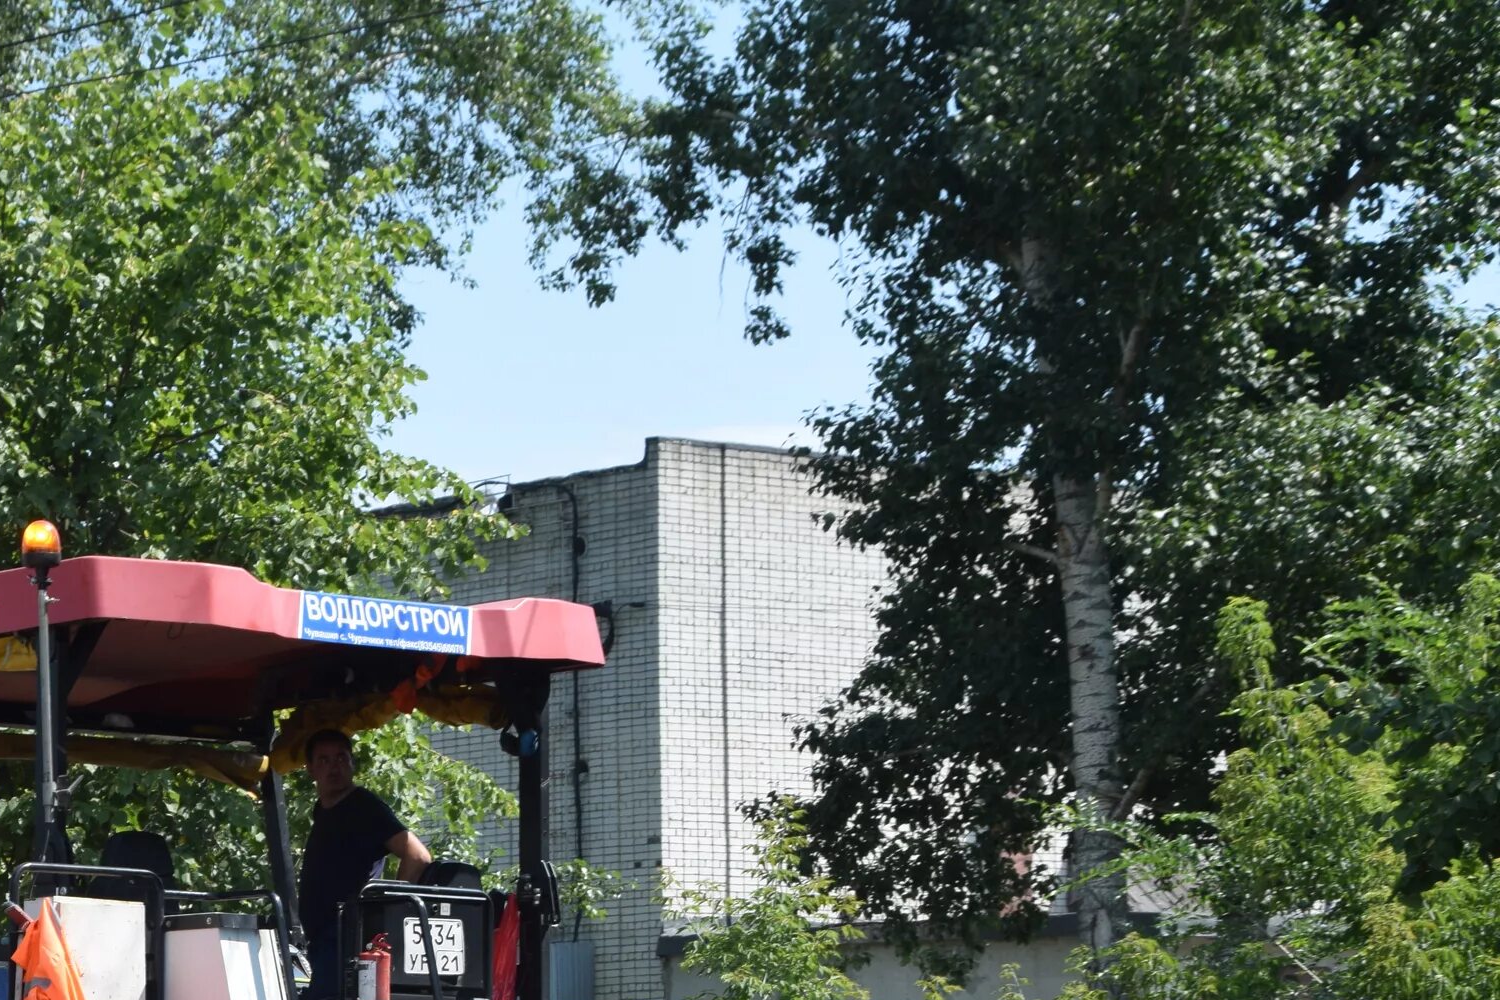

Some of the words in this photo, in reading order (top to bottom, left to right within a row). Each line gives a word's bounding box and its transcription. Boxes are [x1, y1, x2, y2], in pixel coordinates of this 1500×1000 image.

[305, 594, 465, 637] ВОДДОРСТРОЙ
[412, 923, 456, 947] 534
[441, 955, 459, 972] 21
